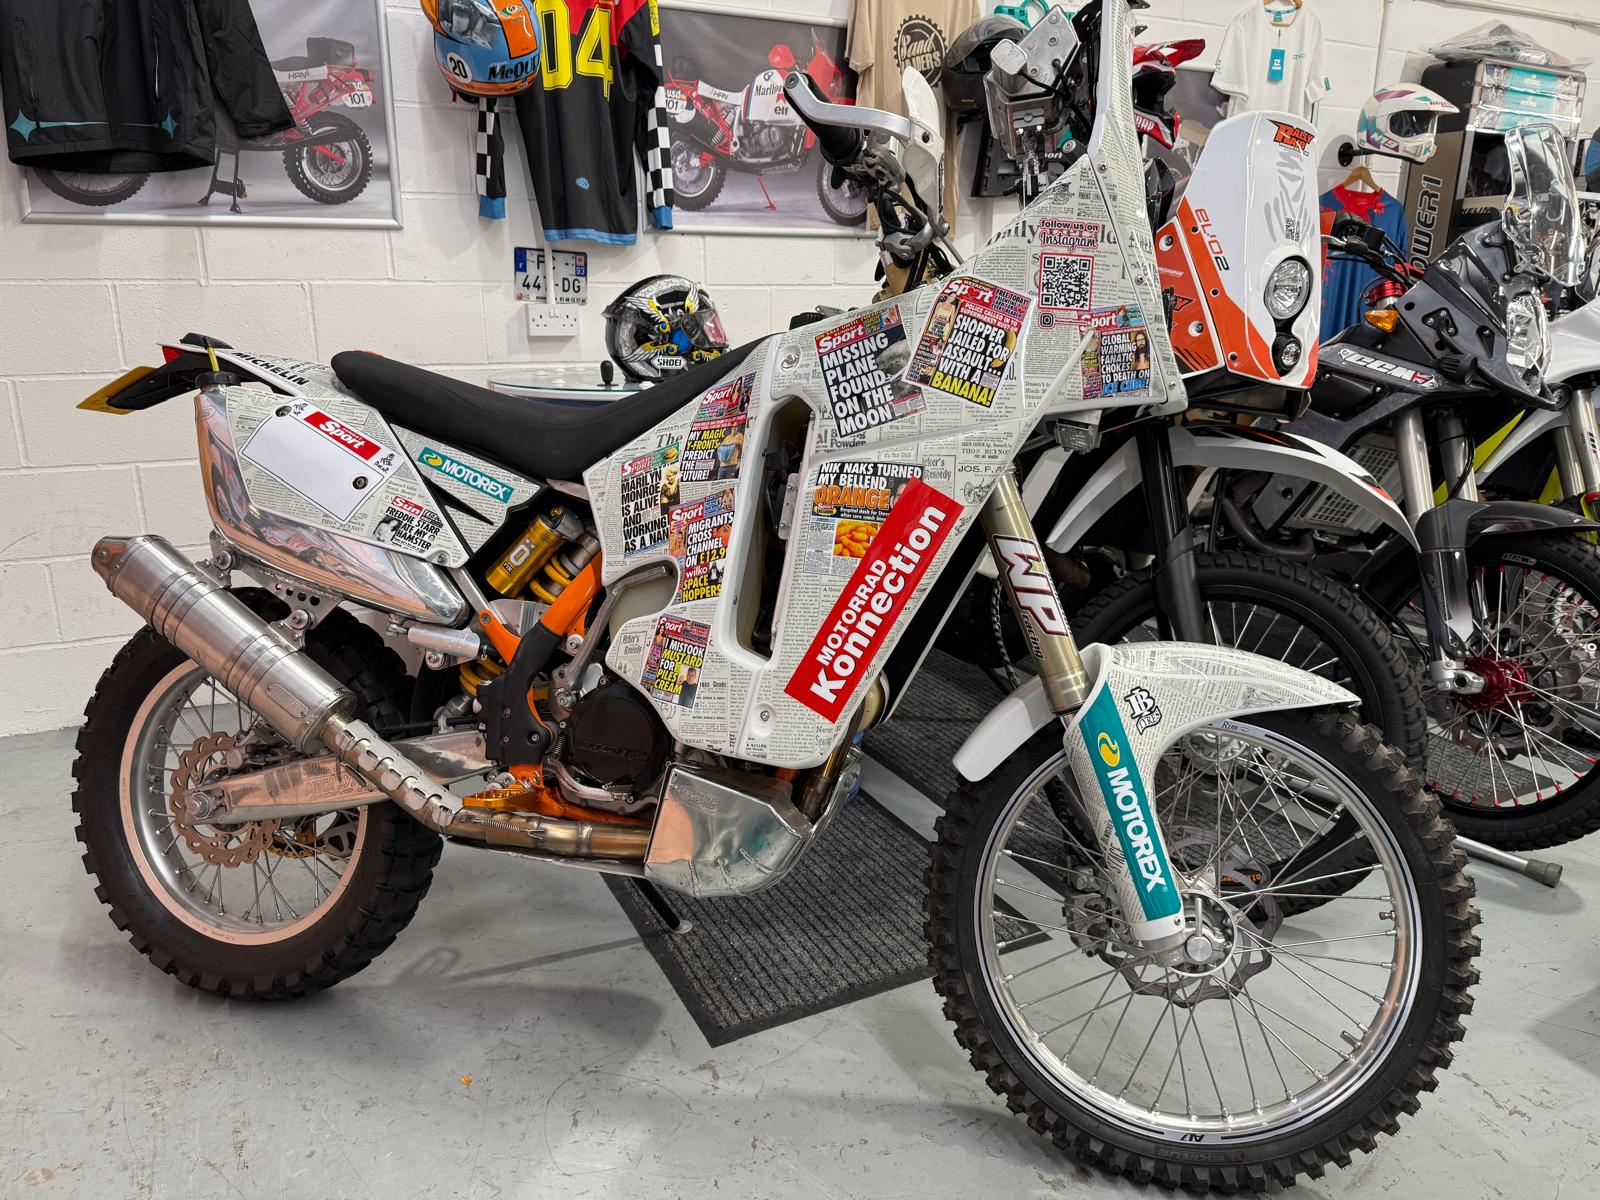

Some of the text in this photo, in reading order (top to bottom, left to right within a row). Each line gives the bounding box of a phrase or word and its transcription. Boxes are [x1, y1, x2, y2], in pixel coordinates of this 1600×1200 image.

[450, 57, 468, 79] 20
[348, 93, 365, 104] 101
[774, 105, 789, 116] elf
[1041, 219, 1099, 232] follow us on
[1041, 231, 1098, 253] Instagram
[576, 267, 585, 275] 93
[522, 274, 581, 294] 44-DG
[964, 303, 983, 314] POLICE
[984, 309, 1004, 321] CALLED
[954, 314, 1006, 345] SHOPPER
[818, 325, 863, 354] Sport
[948, 331, 1010, 362] JAILED FOR
[1101, 332, 1131, 346] GLOBAL
[821, 332, 889, 371] MISSING
[1101, 342, 1137, 355] WARMING
[657, 359, 682, 367] SHOEI
[1101, 353, 1133, 365] FANATIC
[231, 352, 310, 386] MICHELIN
[825, 354, 878, 386] PLANE
[938, 358, 972, 379] WITH
[970, 370, 982, 385] A
[1101, 363, 1131, 375] CHOKES
[1101, 369, 1150, 383] TO DEATH ON
[829, 370, 886, 403] FOUND
[931, 371, 995, 406] BANANA!
[702, 387, 733, 405] Sport
[834, 384, 895, 418] ON THE
[840, 403, 893, 437] MOON
[319, 420, 366, 450] Sport
[656, 433, 683, 448] The
[689, 428, 727, 441] MY MAGIC
[687, 439, 720, 450] Y-FRONTS
[830, 439, 867, 450] Powder
[683, 449, 715, 460] PREDICT
[681, 460, 696, 470] THE
[820, 462, 922, 479] NIK NAKS TURNED
[442, 460, 509, 500] MOTOREX
[622, 469, 661, 494] MARILYN
[680, 470, 710, 481] FUTURE!
[818, 473, 888, 490] MY BELLEND
[621, 481, 660, 506] MONROE
[814, 484, 891, 511] ORANGE
[392, 497, 421, 517] Sun
[621, 494, 660, 517] IS ALIVE
[671, 504, 703, 523] Sport
[386, 506, 415, 524] FREDDIE
[622, 512, 641, 529] AND
[688, 512, 734, 535] MIGRANTS
[400, 522, 428, 539] ATE MY
[415, 517, 440, 535] STARR
[623, 515, 668, 541] WORKING
[396, 530, 432, 550] HAMSTER
[624, 538, 637, 553] AS
[639, 536, 647, 546] A
[687, 529, 712, 545] CROSS
[686, 537, 723, 556] CHANNEL
[685, 547, 727, 568] ON £12.9
[685, 566, 708, 578] wilko
[683, 575, 709, 591] SPACE
[992, 535, 1069, 636] WP
[682, 583, 721, 603] HOPPERS
[810, 506, 947, 704] Konnection
[816, 560, 887, 666] MOTORRAD
[1021, 613, 1045, 660] racing
[669, 640, 705, 657] MISTOOK
[659, 658, 675, 671] FOR
[662, 648, 703, 668] MUSTARD
[657, 668, 678, 683] PILES
[654, 677, 683, 695] CREAM
[1222, 720, 1239, 730] Rim
[1107, 767, 1166, 892] MOTOREX
